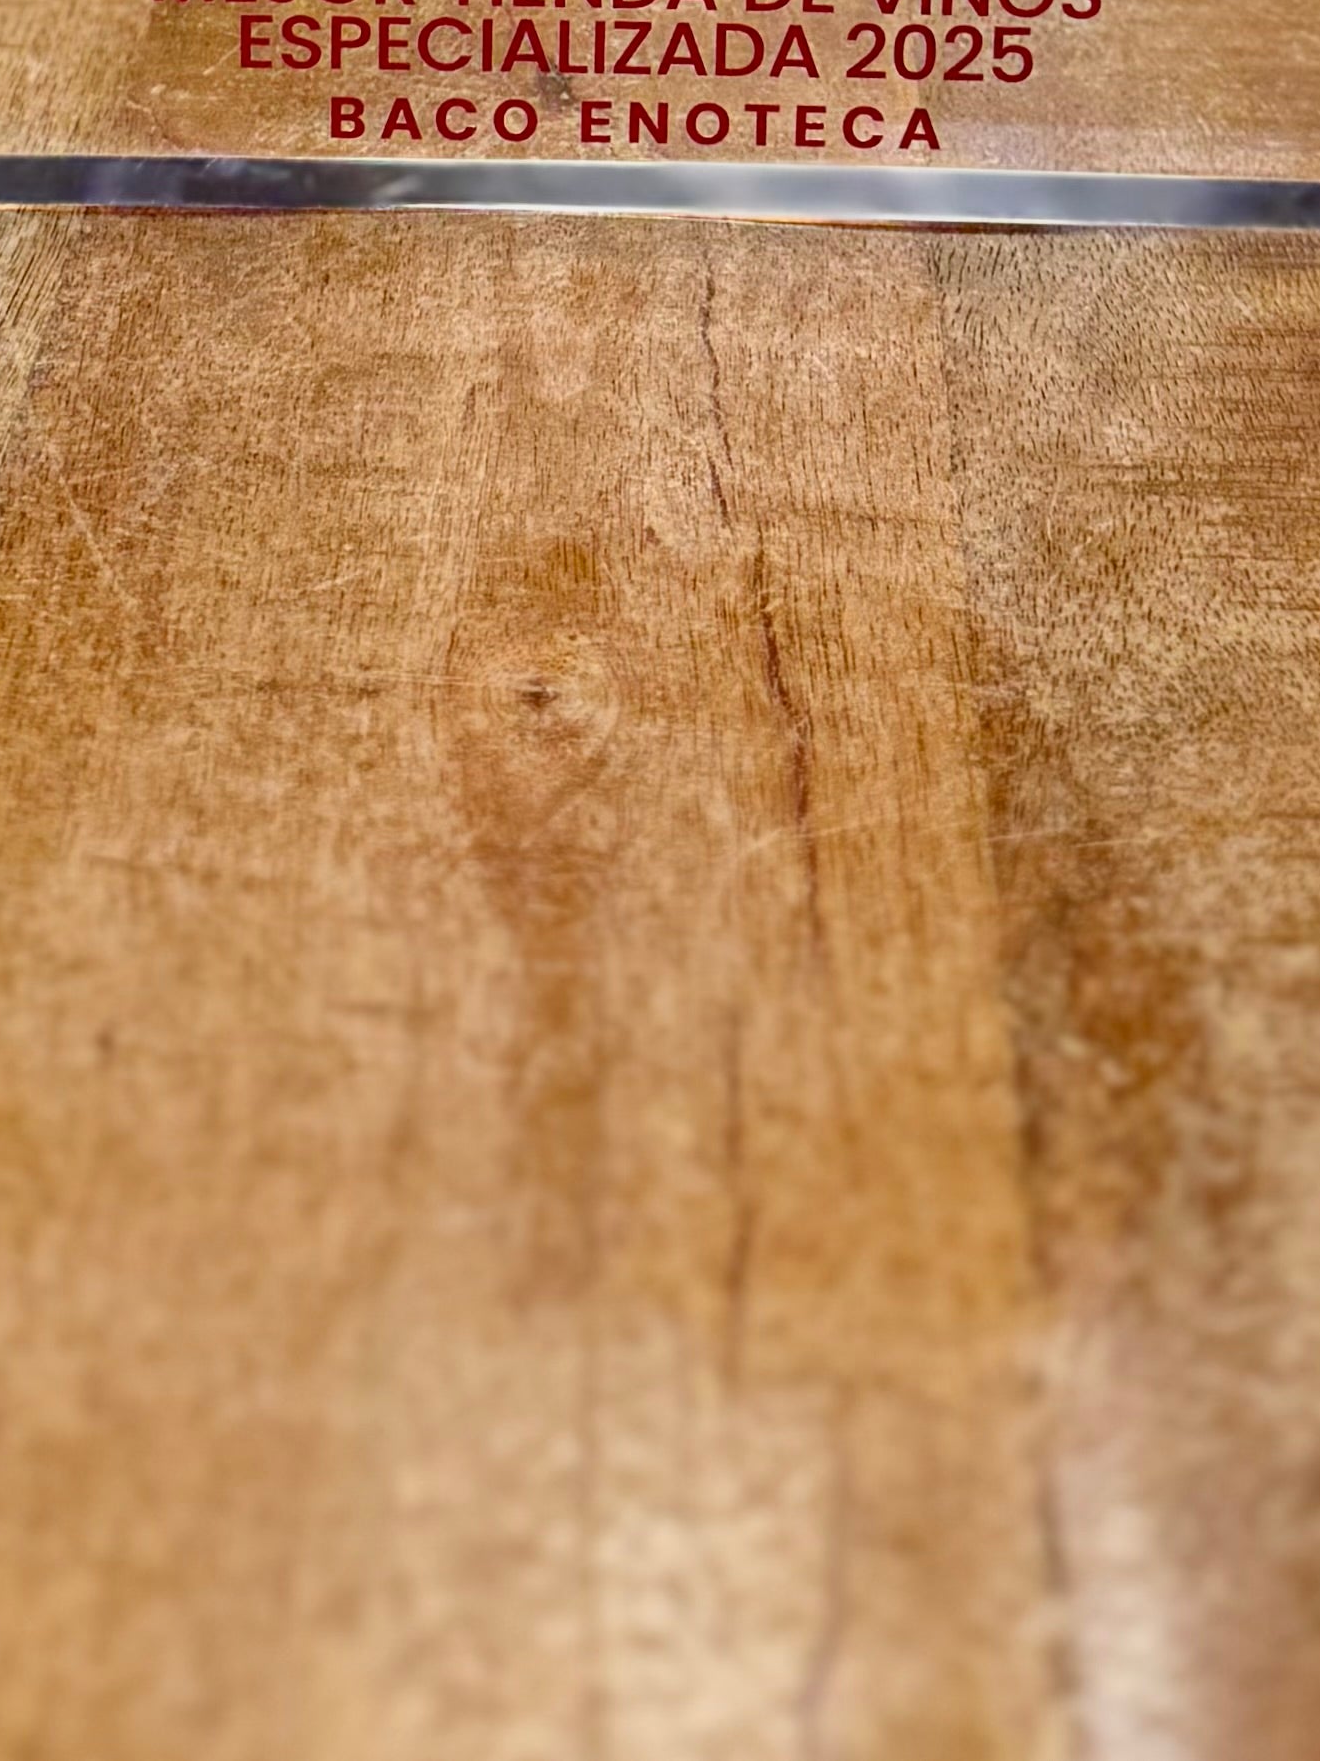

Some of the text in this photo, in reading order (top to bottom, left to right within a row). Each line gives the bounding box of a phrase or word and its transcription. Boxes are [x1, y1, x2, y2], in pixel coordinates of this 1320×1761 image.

[238, 13, 1035, 84] ESPECIALIZADA 2025
[329, 95, 942, 151] BACO ENOTECA
